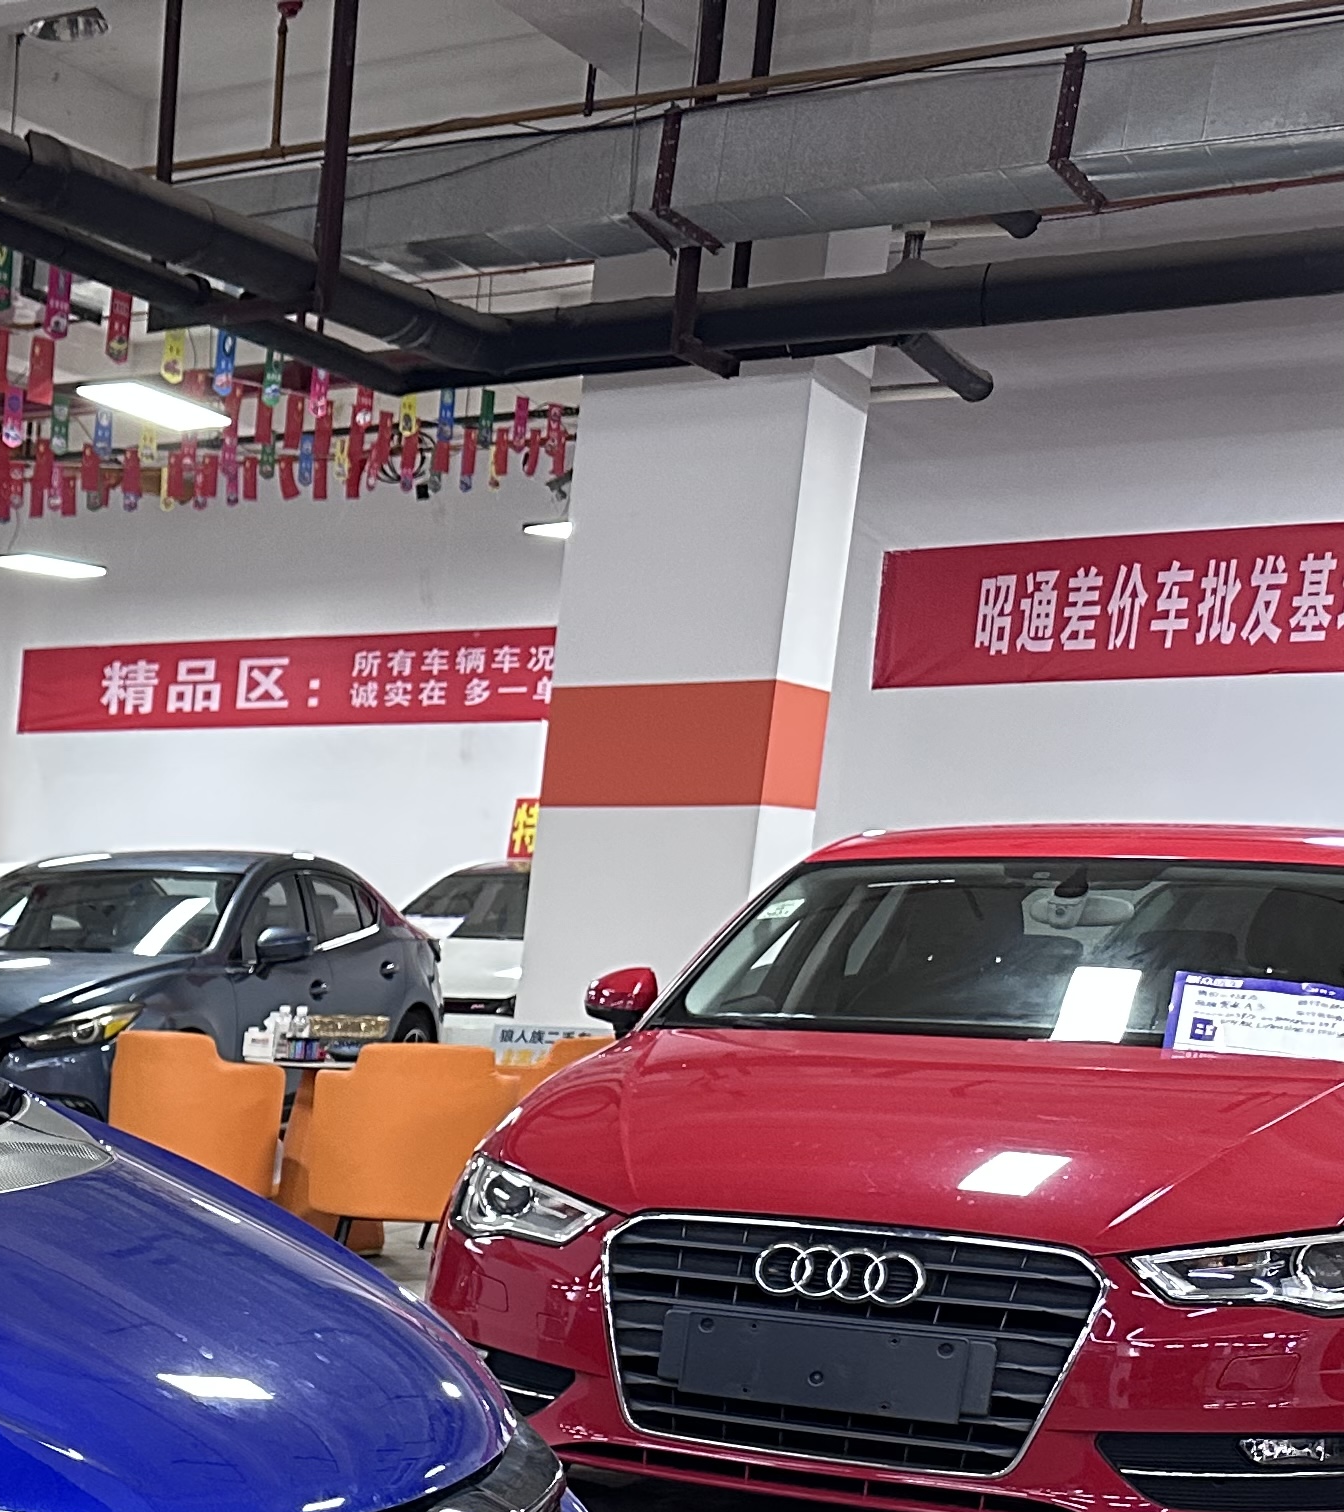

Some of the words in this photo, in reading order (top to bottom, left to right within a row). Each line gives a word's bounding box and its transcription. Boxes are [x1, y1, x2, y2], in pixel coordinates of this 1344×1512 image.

[974, 552, 1344, 654] 昭通差价车批发基
[351, 644, 555, 678] 所有车辆车况
[349, 678, 448, 709] 诚实在
